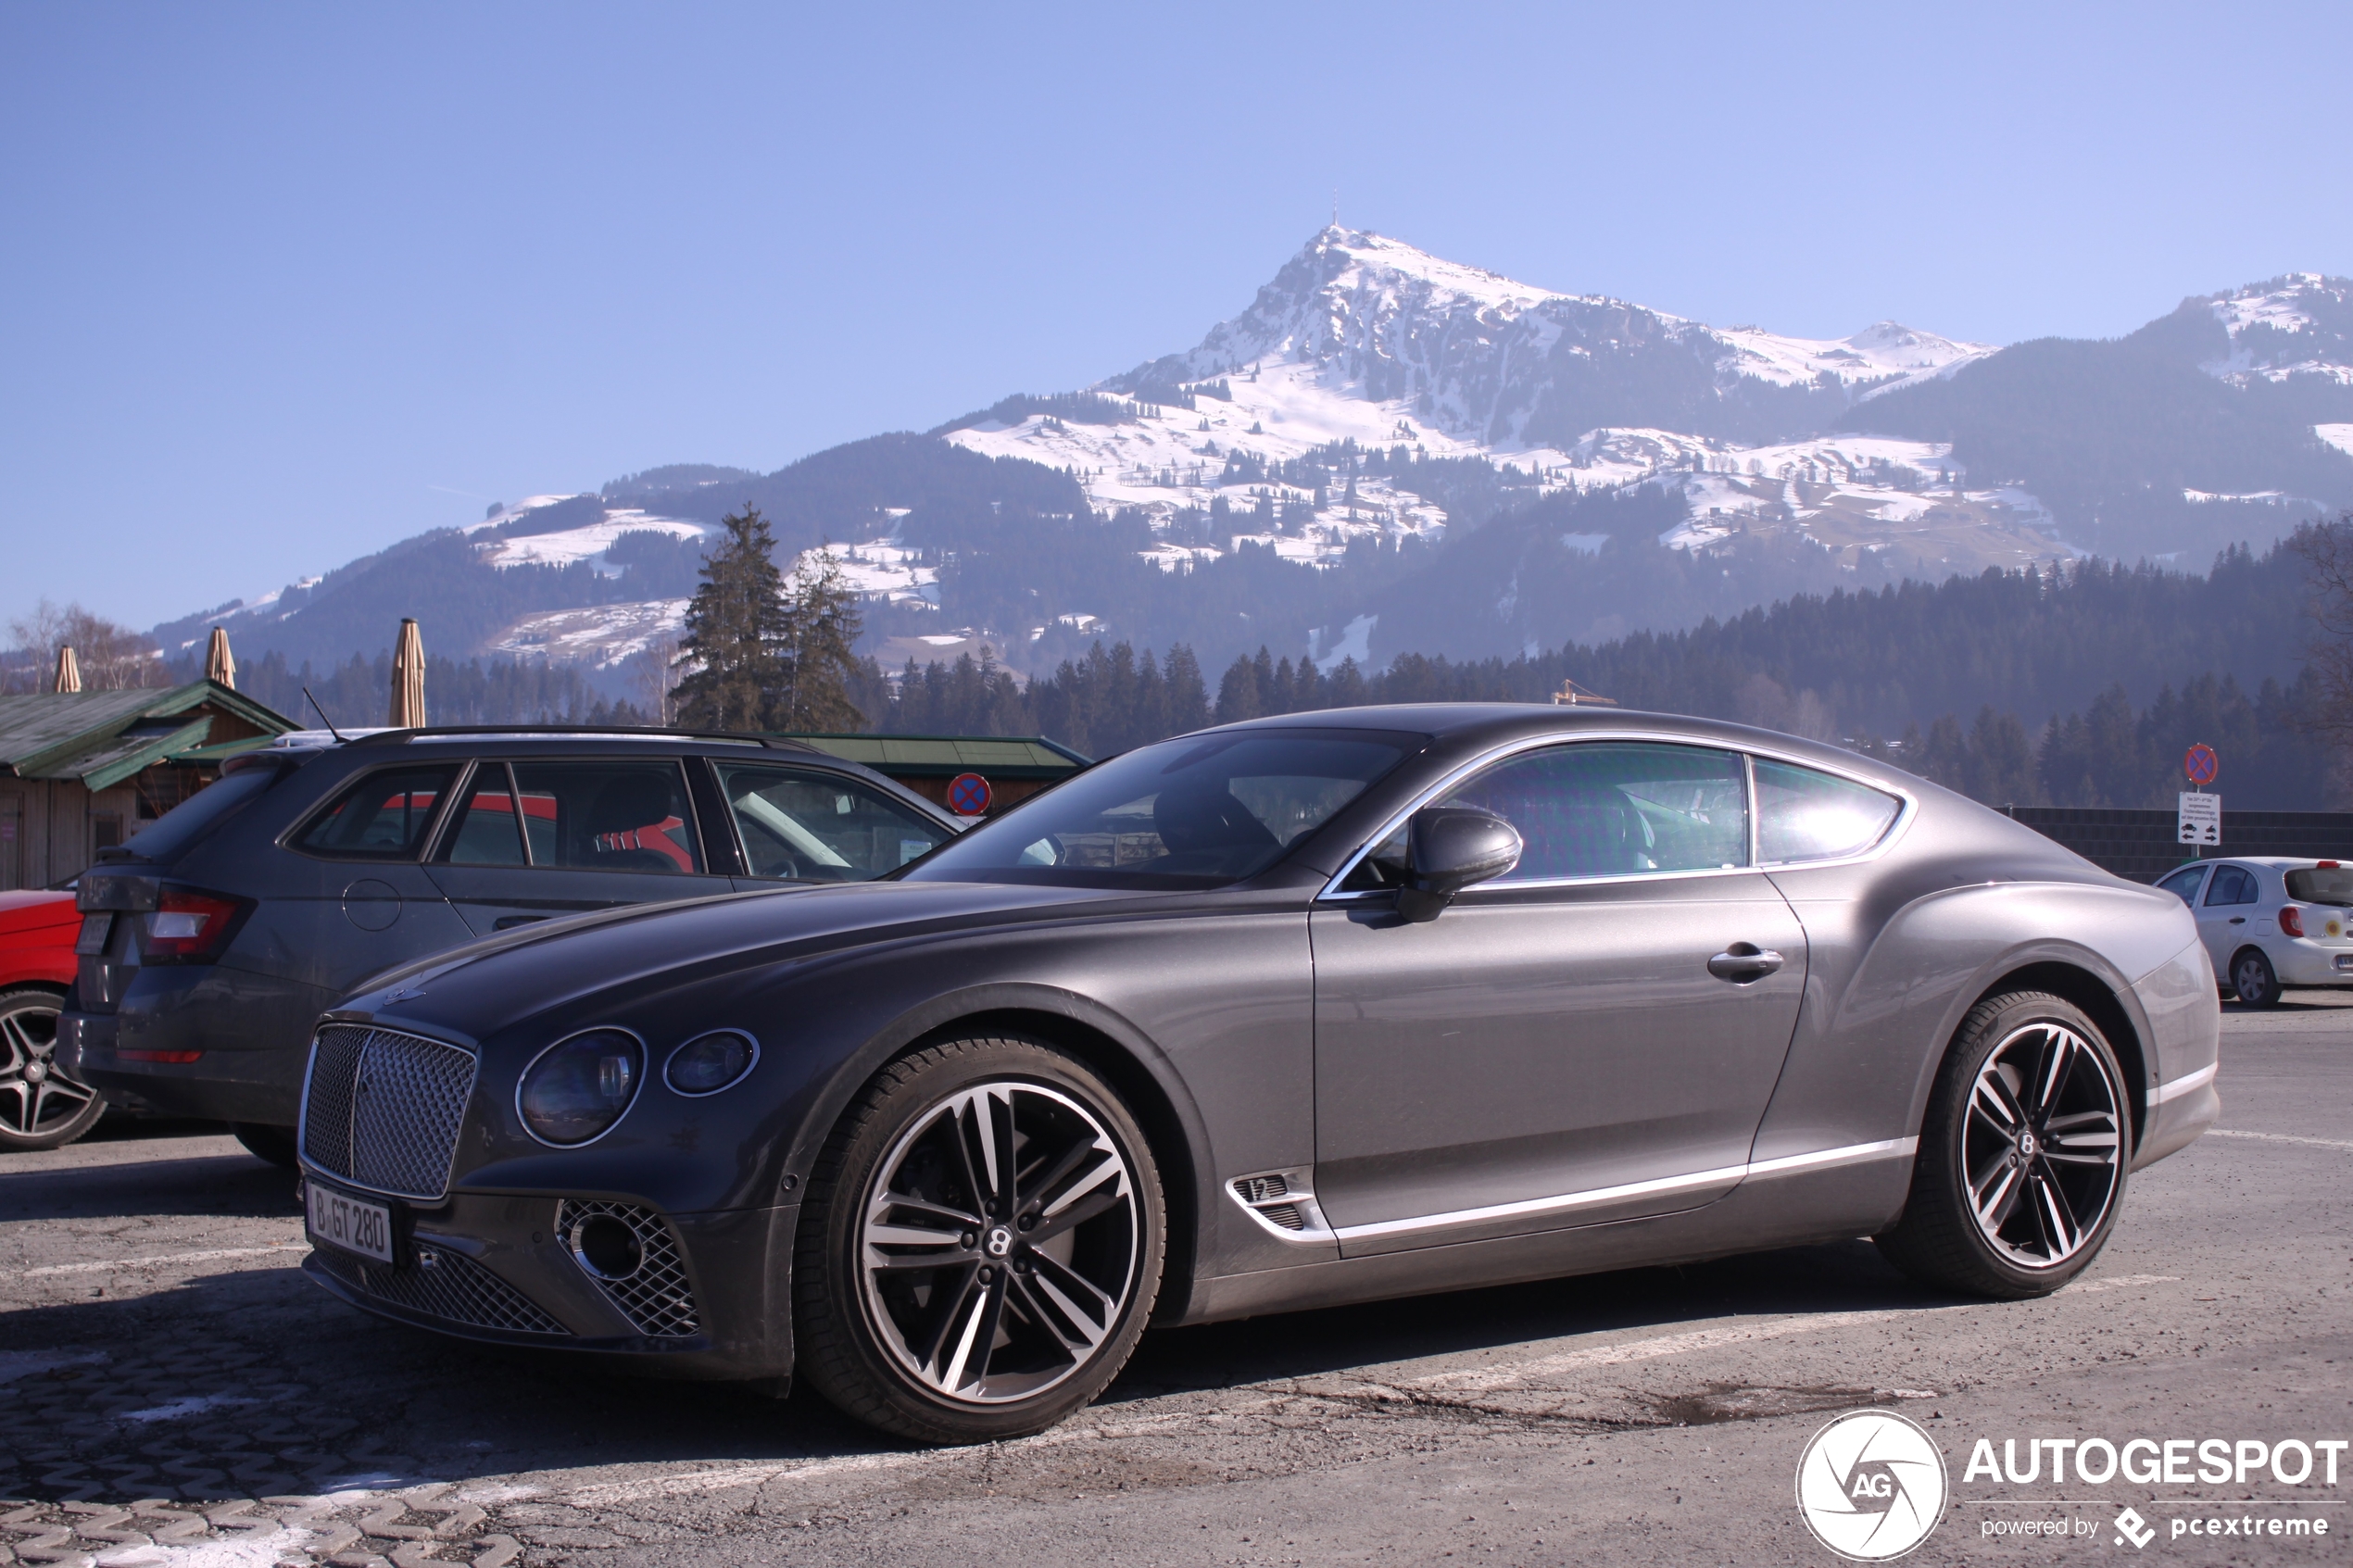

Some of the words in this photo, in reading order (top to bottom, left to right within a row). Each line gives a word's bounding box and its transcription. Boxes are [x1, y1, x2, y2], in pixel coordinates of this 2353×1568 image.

[316, 1190, 326, 1232] B
[332, 1198, 349, 1243] GT
[353, 1205, 385, 1254] 280
